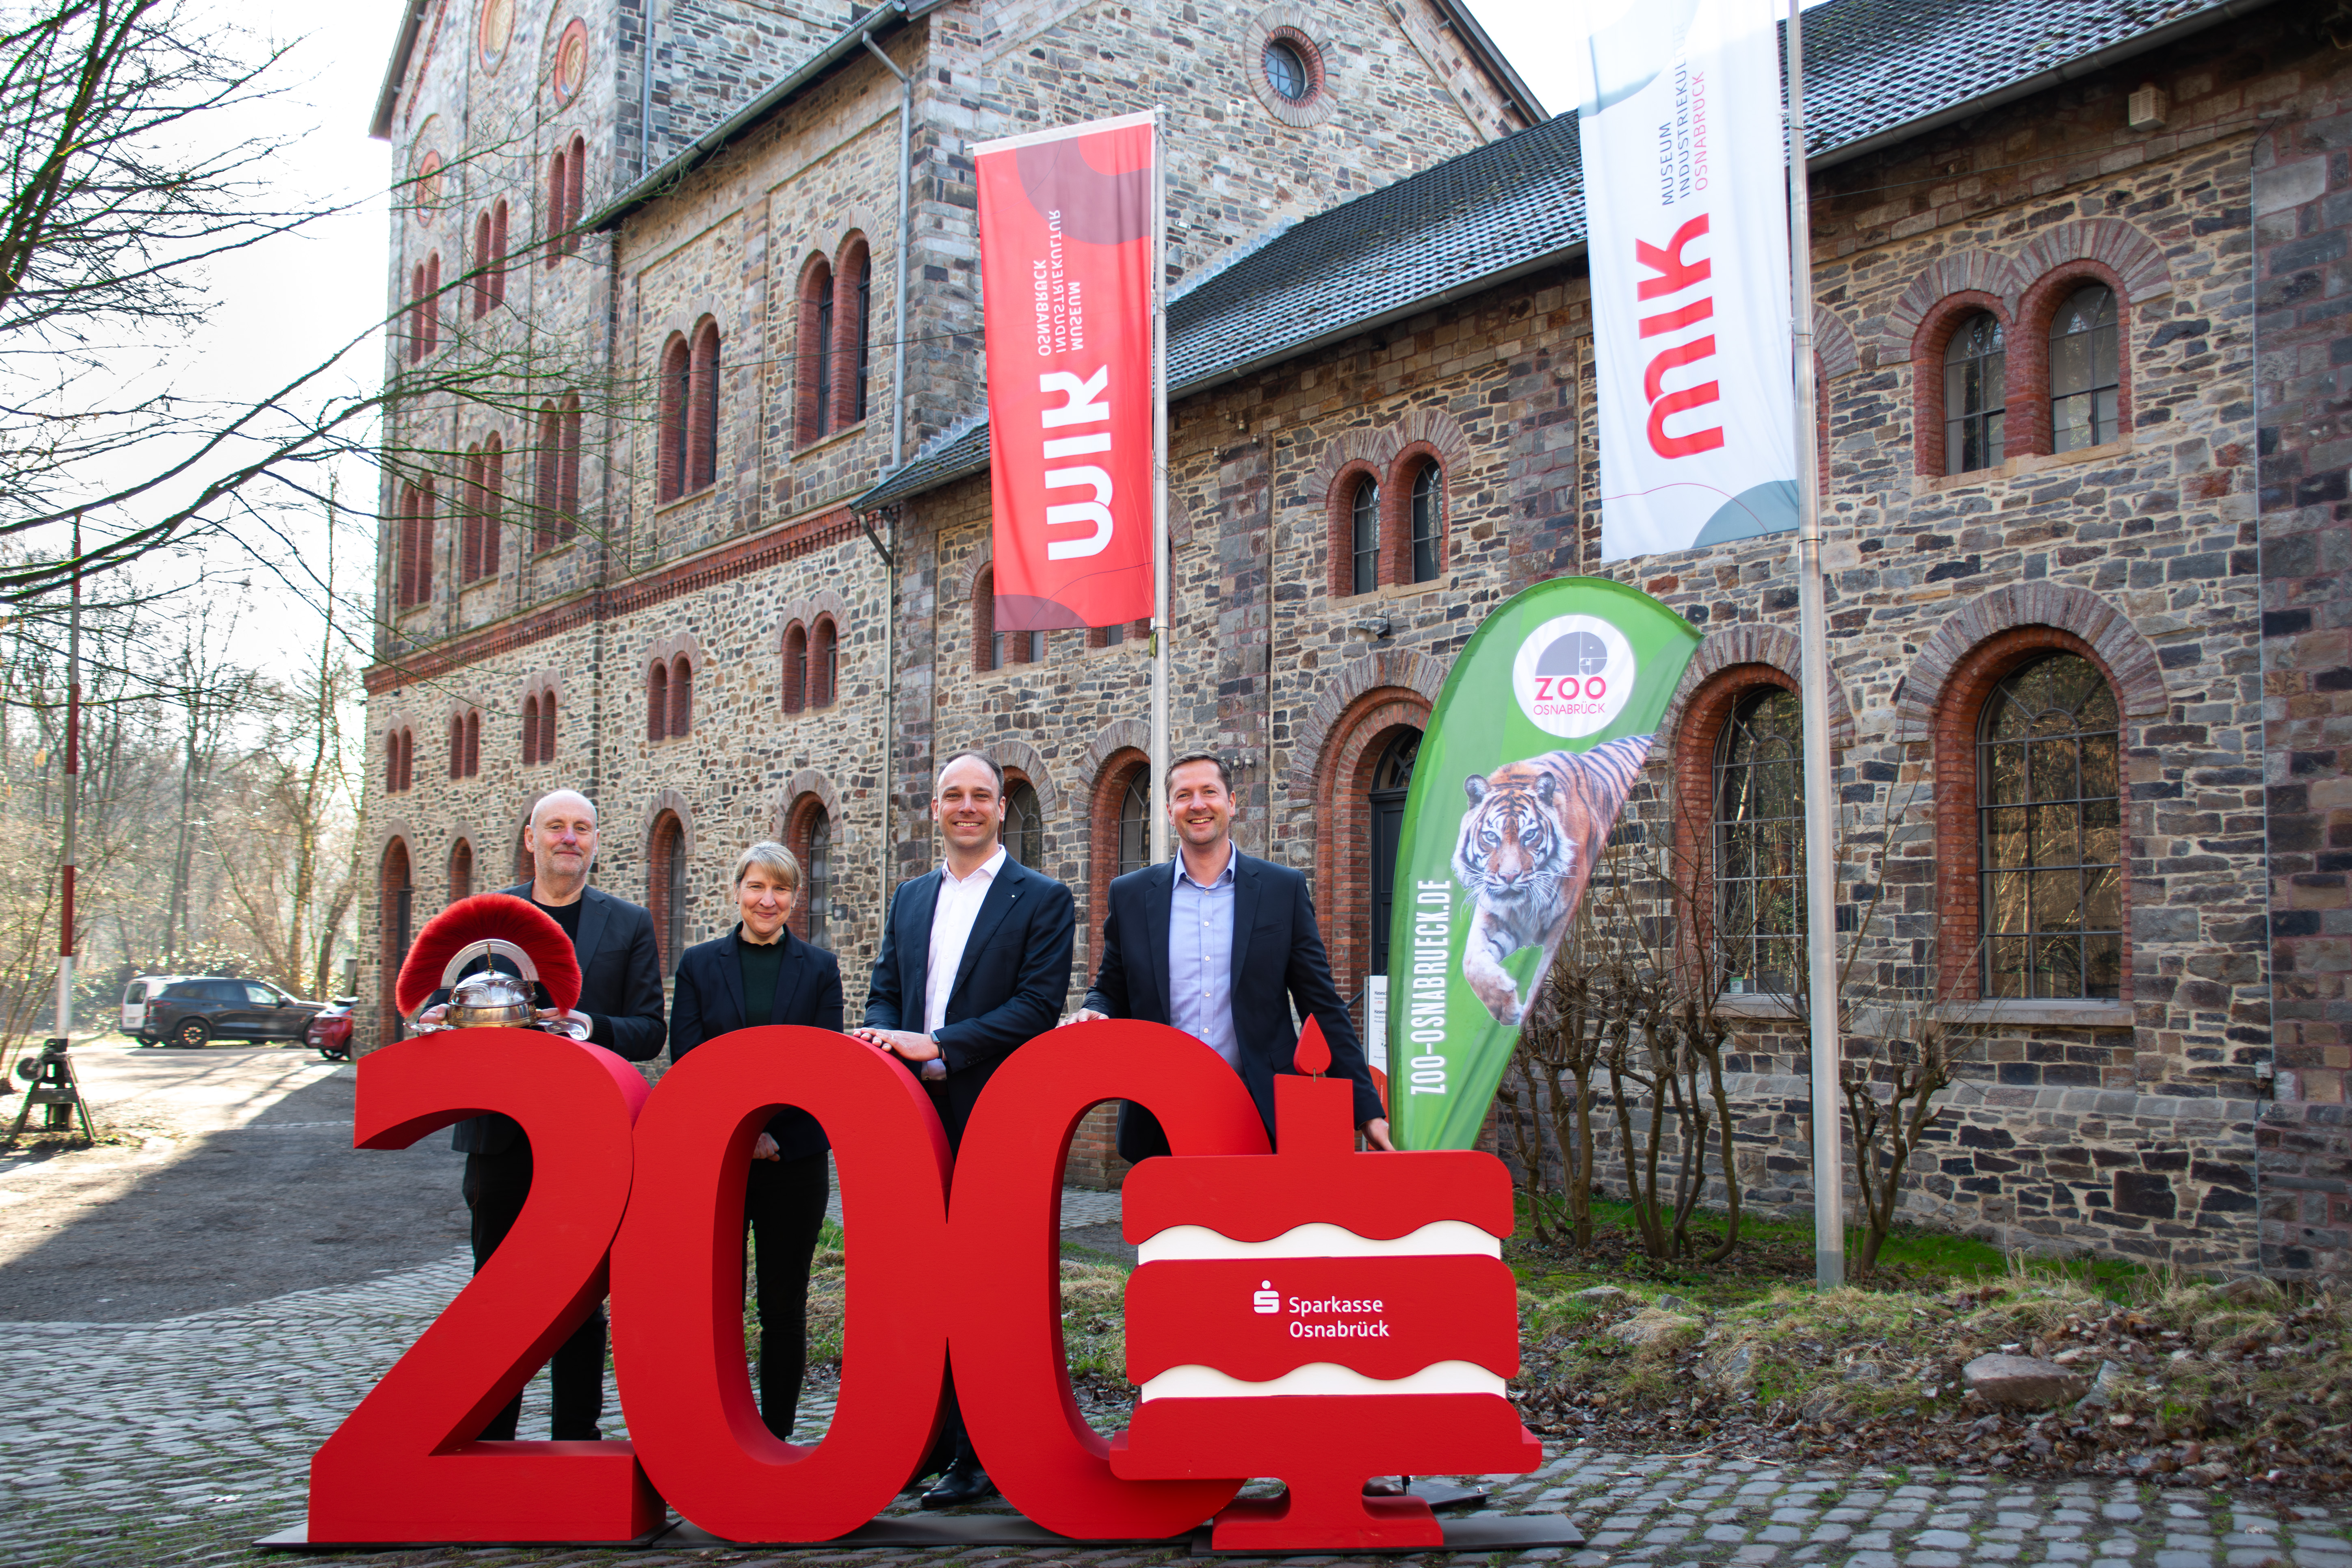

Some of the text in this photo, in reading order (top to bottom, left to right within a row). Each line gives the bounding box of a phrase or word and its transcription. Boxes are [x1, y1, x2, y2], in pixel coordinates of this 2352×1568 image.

[1673, 22, 1690, 199] INDUSTRIEKULTUR
[1659, 121, 1674, 206] MUSEUM
[1534, 676, 1606, 701] ZOO
[1533, 701, 1605, 715] OSNABRÜCK
[1410, 880, 1450, 1095] ZOO-OSNABRUECK.DE
[1289, 1295, 1383, 1317] Sparkasse
[1289, 1319, 1390, 1338] Osnabrück
